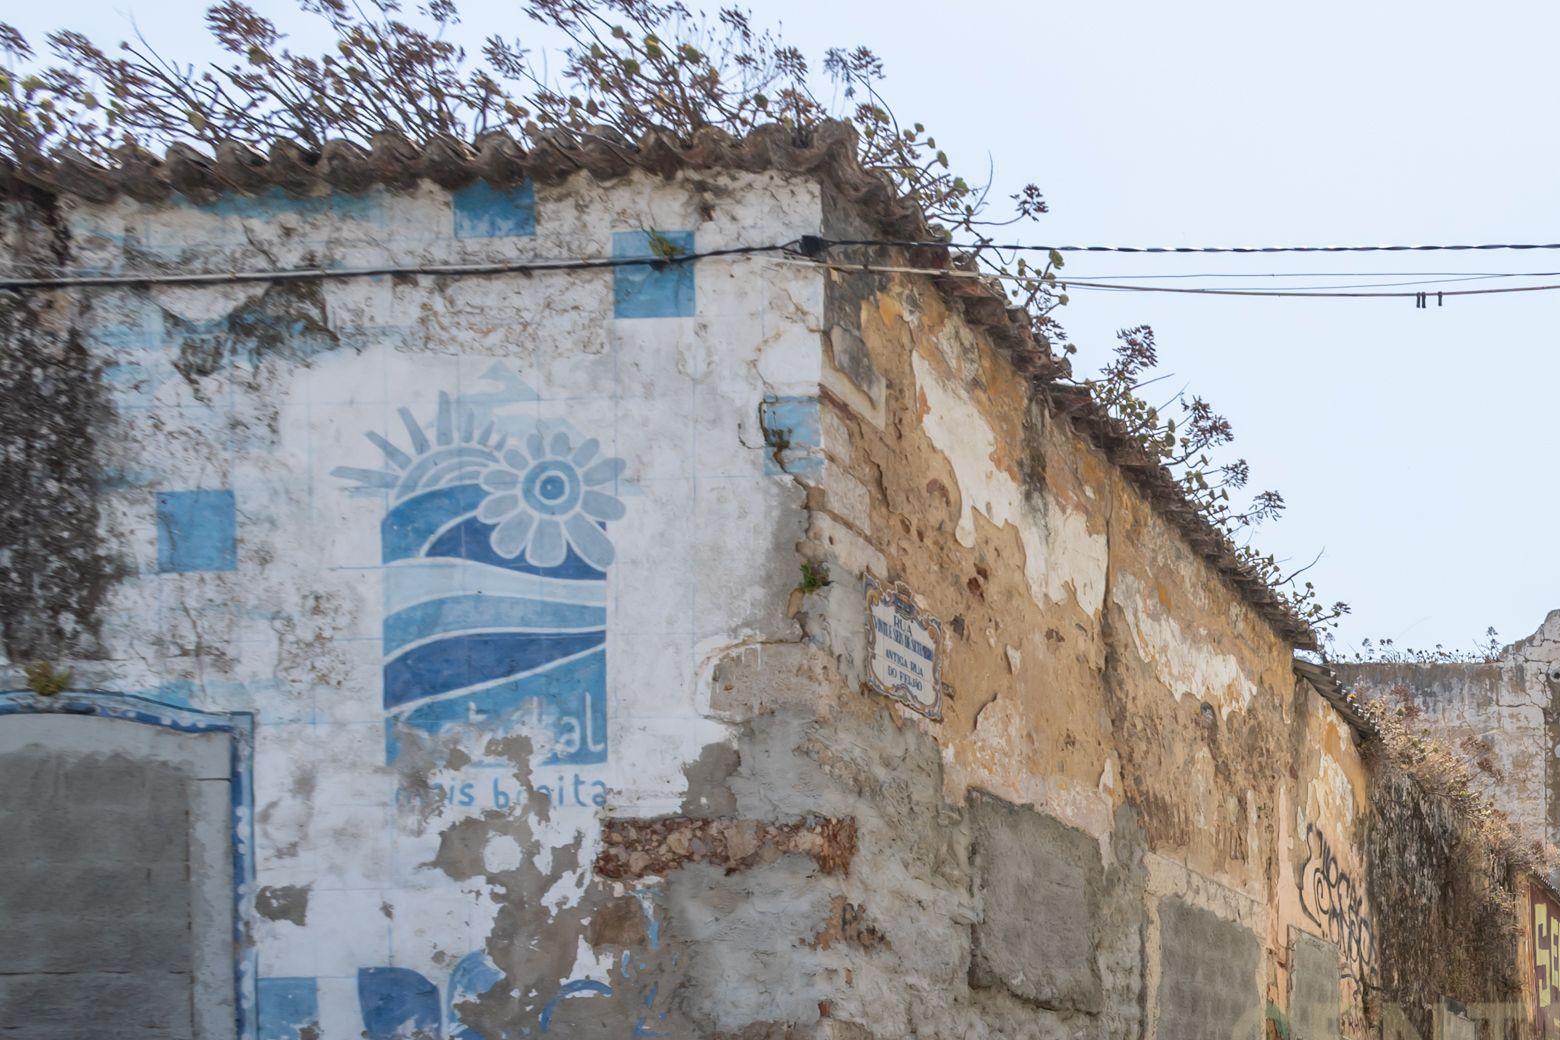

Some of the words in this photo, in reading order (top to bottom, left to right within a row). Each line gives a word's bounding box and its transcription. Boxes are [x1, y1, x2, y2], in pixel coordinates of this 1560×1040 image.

[894, 615, 912, 637] RUA
[886, 649, 908, 668] ANTIGA
[911, 661, 923, 677] RUA
